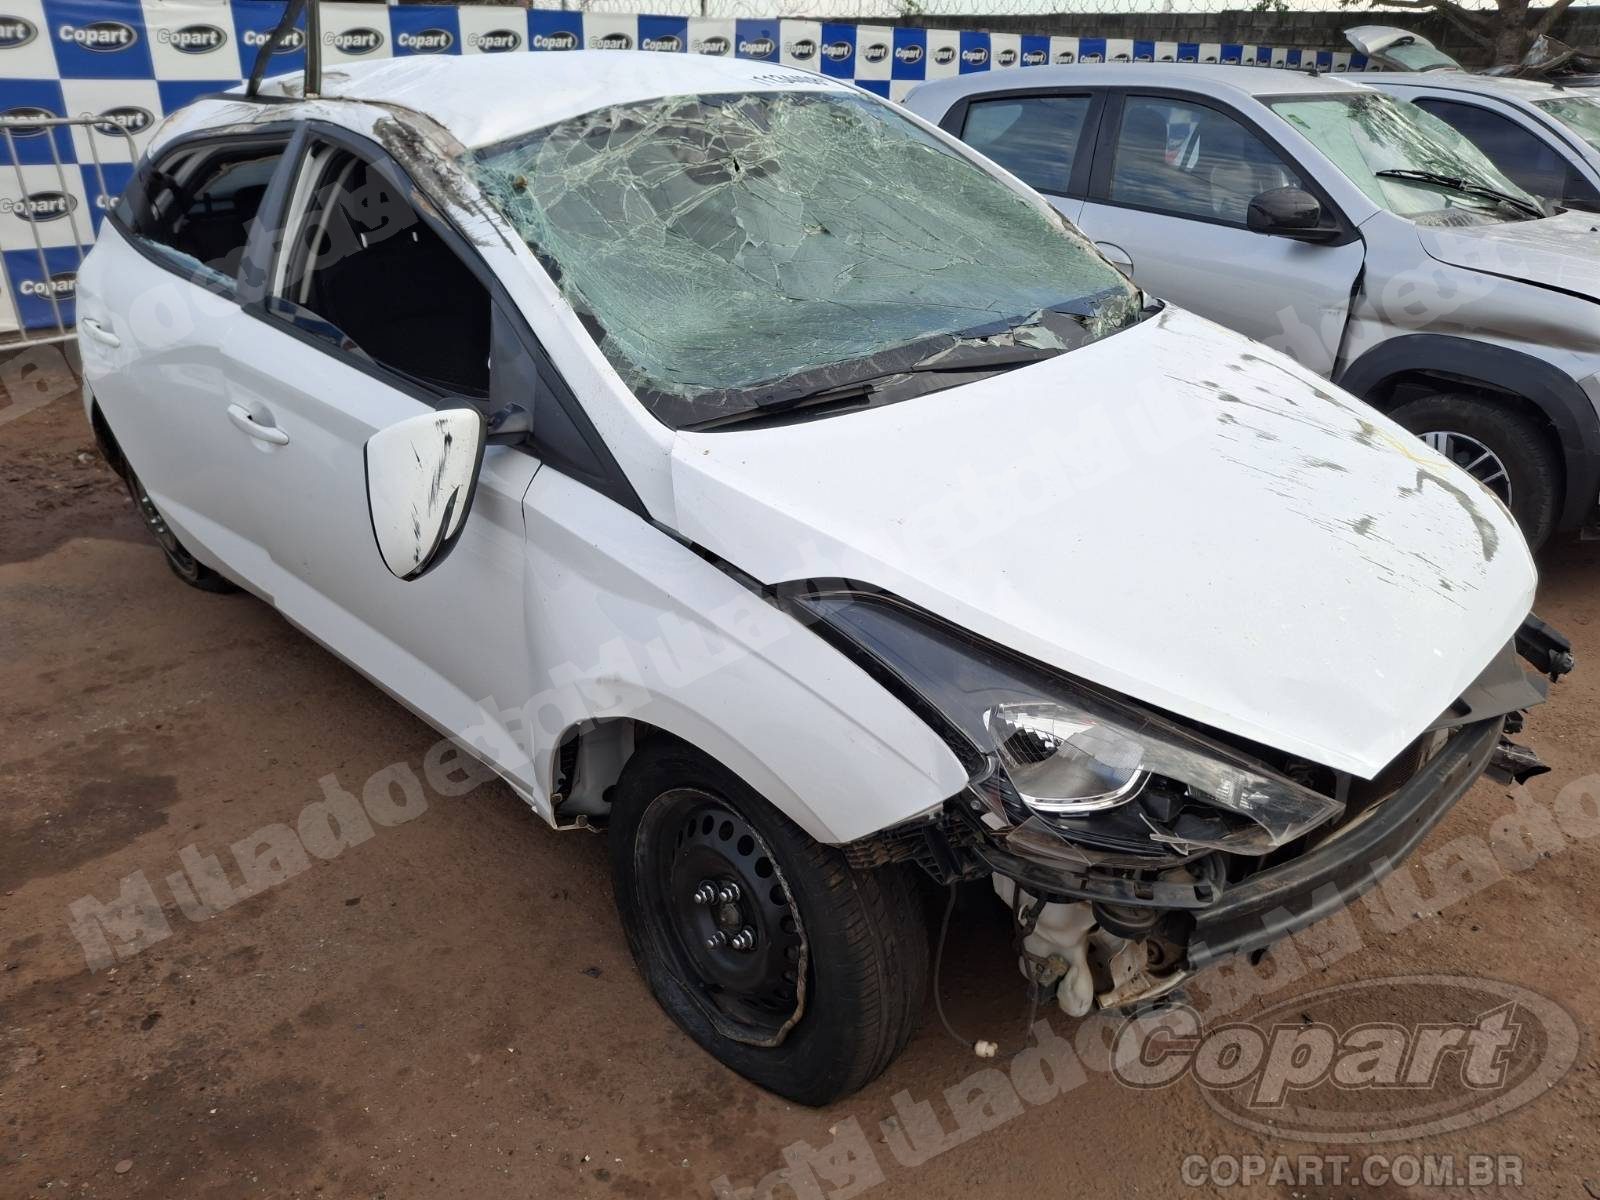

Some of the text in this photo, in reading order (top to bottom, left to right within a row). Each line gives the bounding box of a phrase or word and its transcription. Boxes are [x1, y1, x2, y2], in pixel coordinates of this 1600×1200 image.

[59, 25, 128, 46] Copart
[157, 28, 218, 47] Copart
[243, 31, 300, 46] Cort
[323, 31, 375, 48] Copart
[397, 32, 447, 49] Copart
[467, 33, 515, 49] Copart
[533, 35, 573, 49] Copart
[589, 36, 628, 50] Copart
[642, 38, 678, 52] Copart
[694, 39, 726, 53] Copart
[739, 40, 771, 54] Copart
[785, 41, 814, 55] Copart
[822, 43, 849, 56] Copart
[895, 47, 921, 59] Copart
[20, 279, 76, 295] Copar
